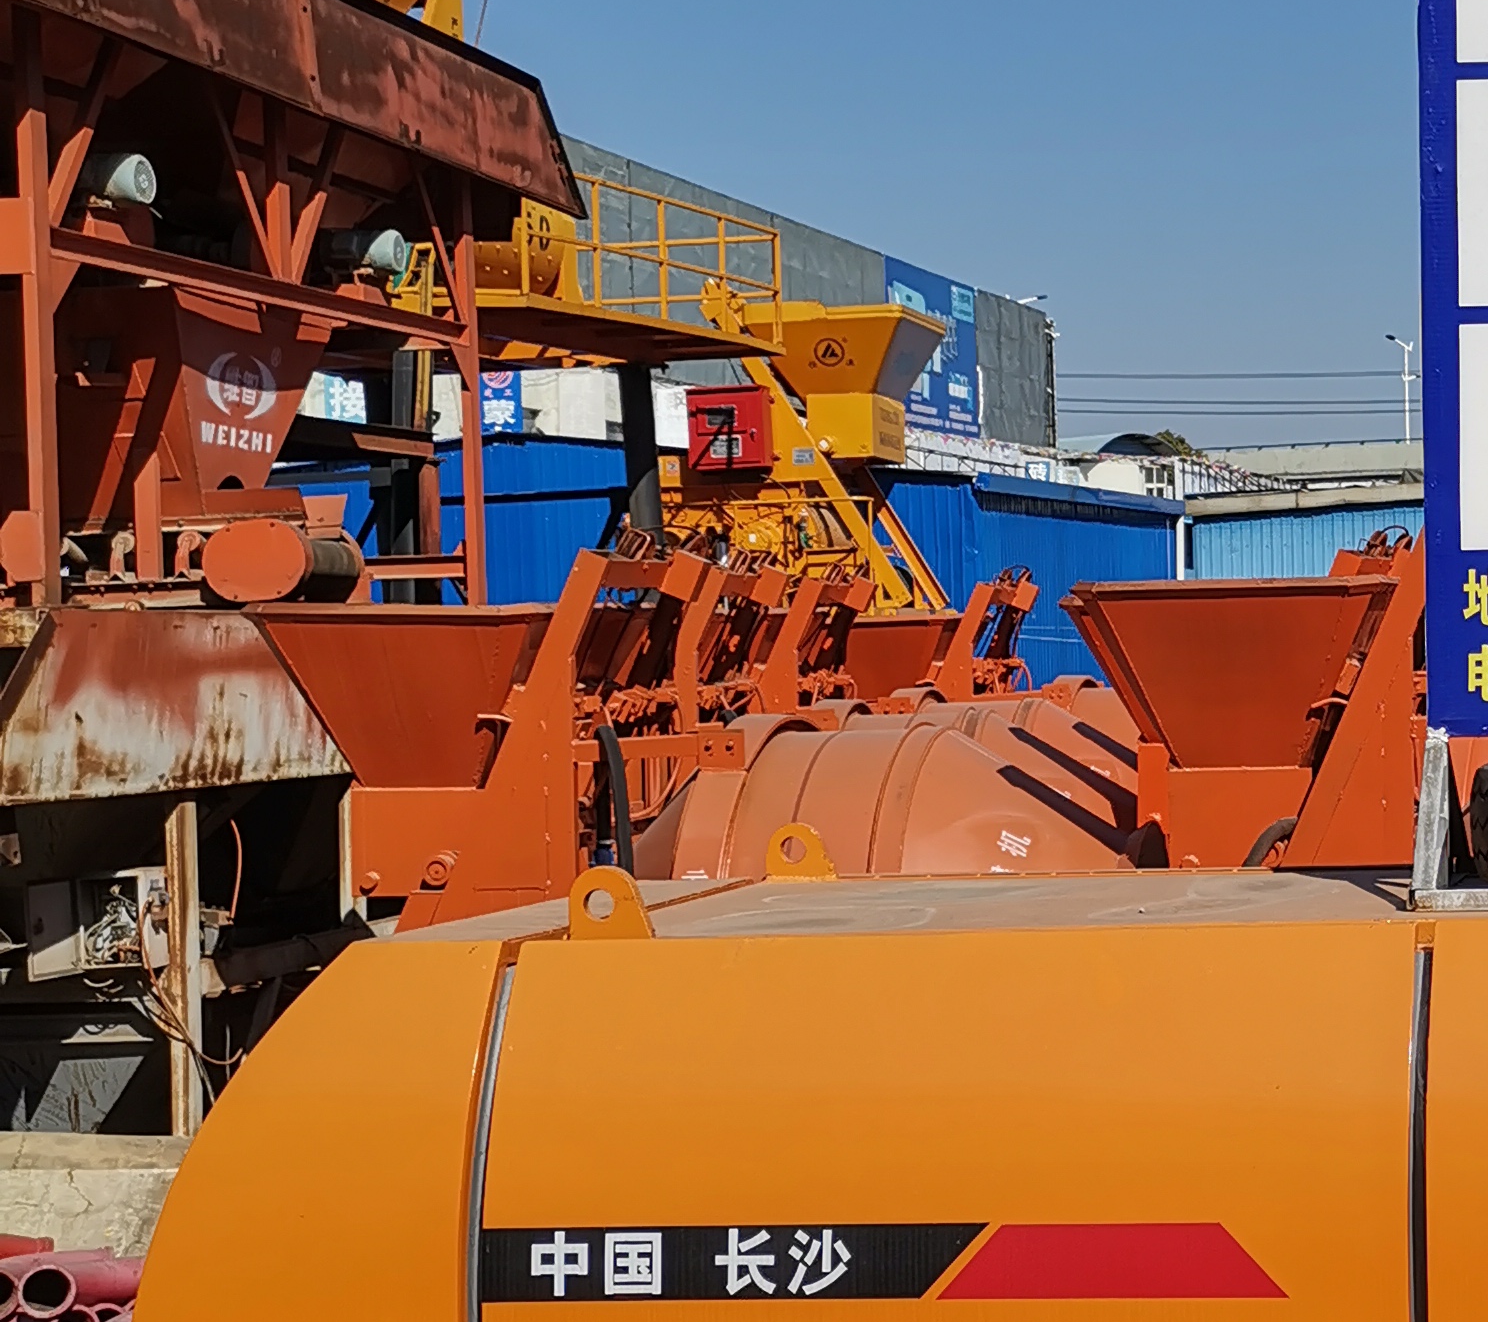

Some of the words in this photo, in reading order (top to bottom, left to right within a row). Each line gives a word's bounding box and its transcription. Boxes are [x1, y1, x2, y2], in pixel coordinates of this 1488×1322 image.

[200, 421, 273, 453] WEIZHI
[529, 1230, 661, 1297] 中国
[715, 1227, 851, 1296] 长沙
